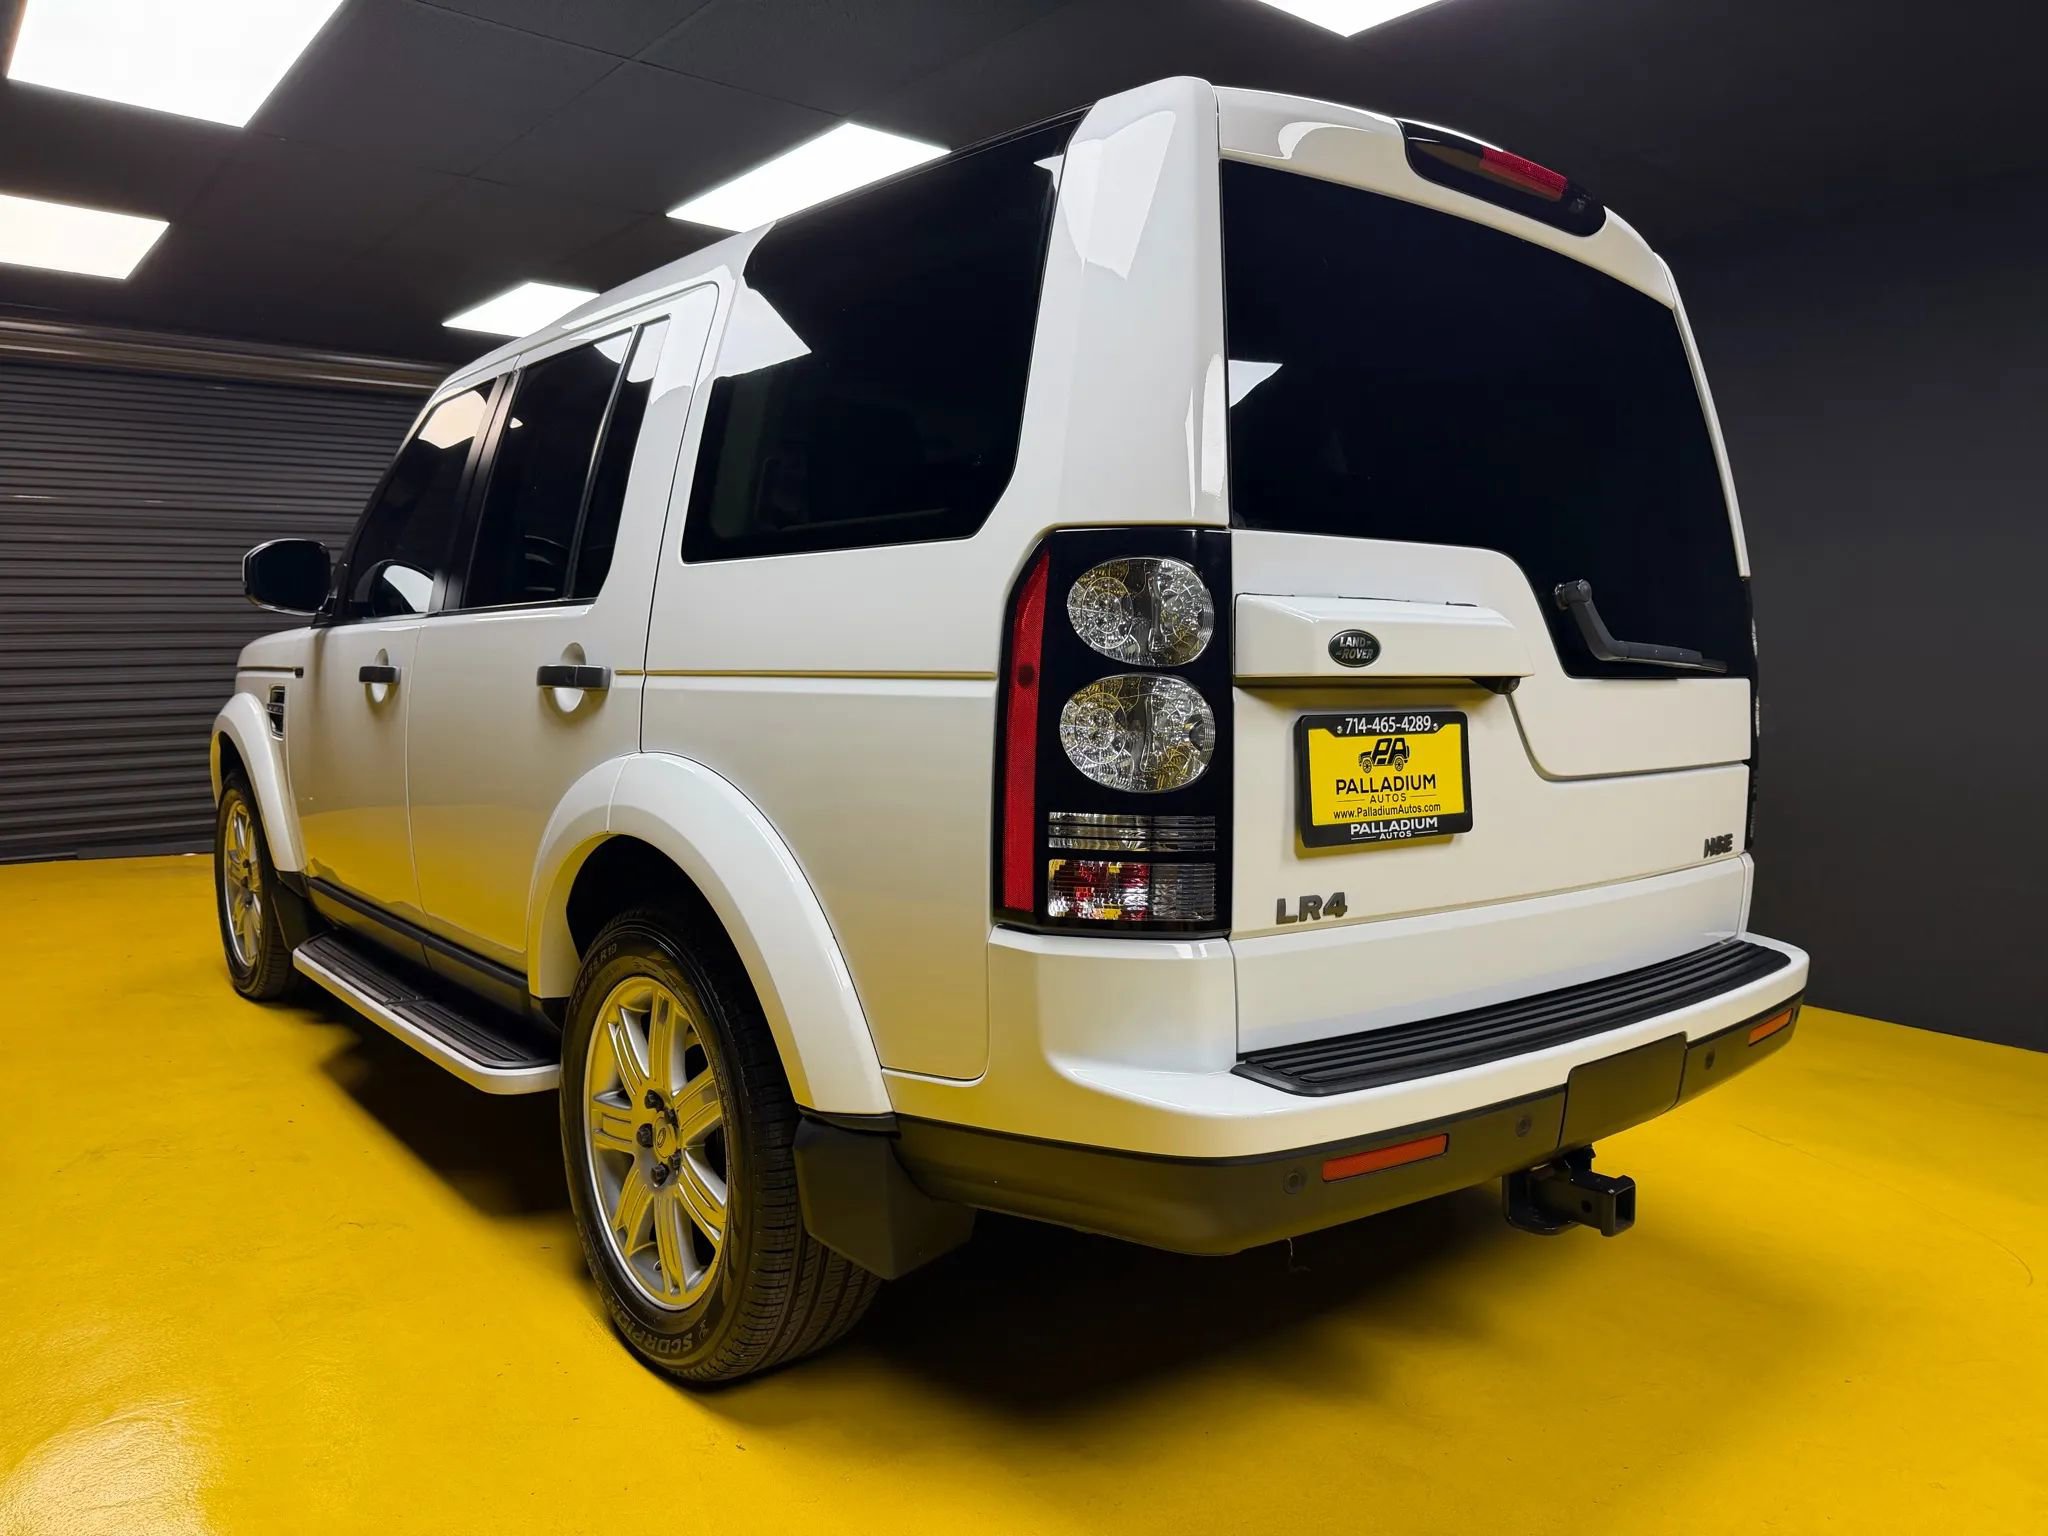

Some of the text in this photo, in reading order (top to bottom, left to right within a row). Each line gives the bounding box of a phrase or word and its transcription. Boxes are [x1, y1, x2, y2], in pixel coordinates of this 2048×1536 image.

[1345, 715, 1431, 734] 714-465-4289
[1336, 774, 1436, 795] PALLADIUM
[1370, 793, 1407, 804] AUTOS
[1334, 803, 1441, 819] www.PalladiumAutos.com
[1351, 817, 1438, 835] PALLADIUM
[1380, 830, 1412, 840] AUTOS
[1276, 892, 1348, 925] LR4
